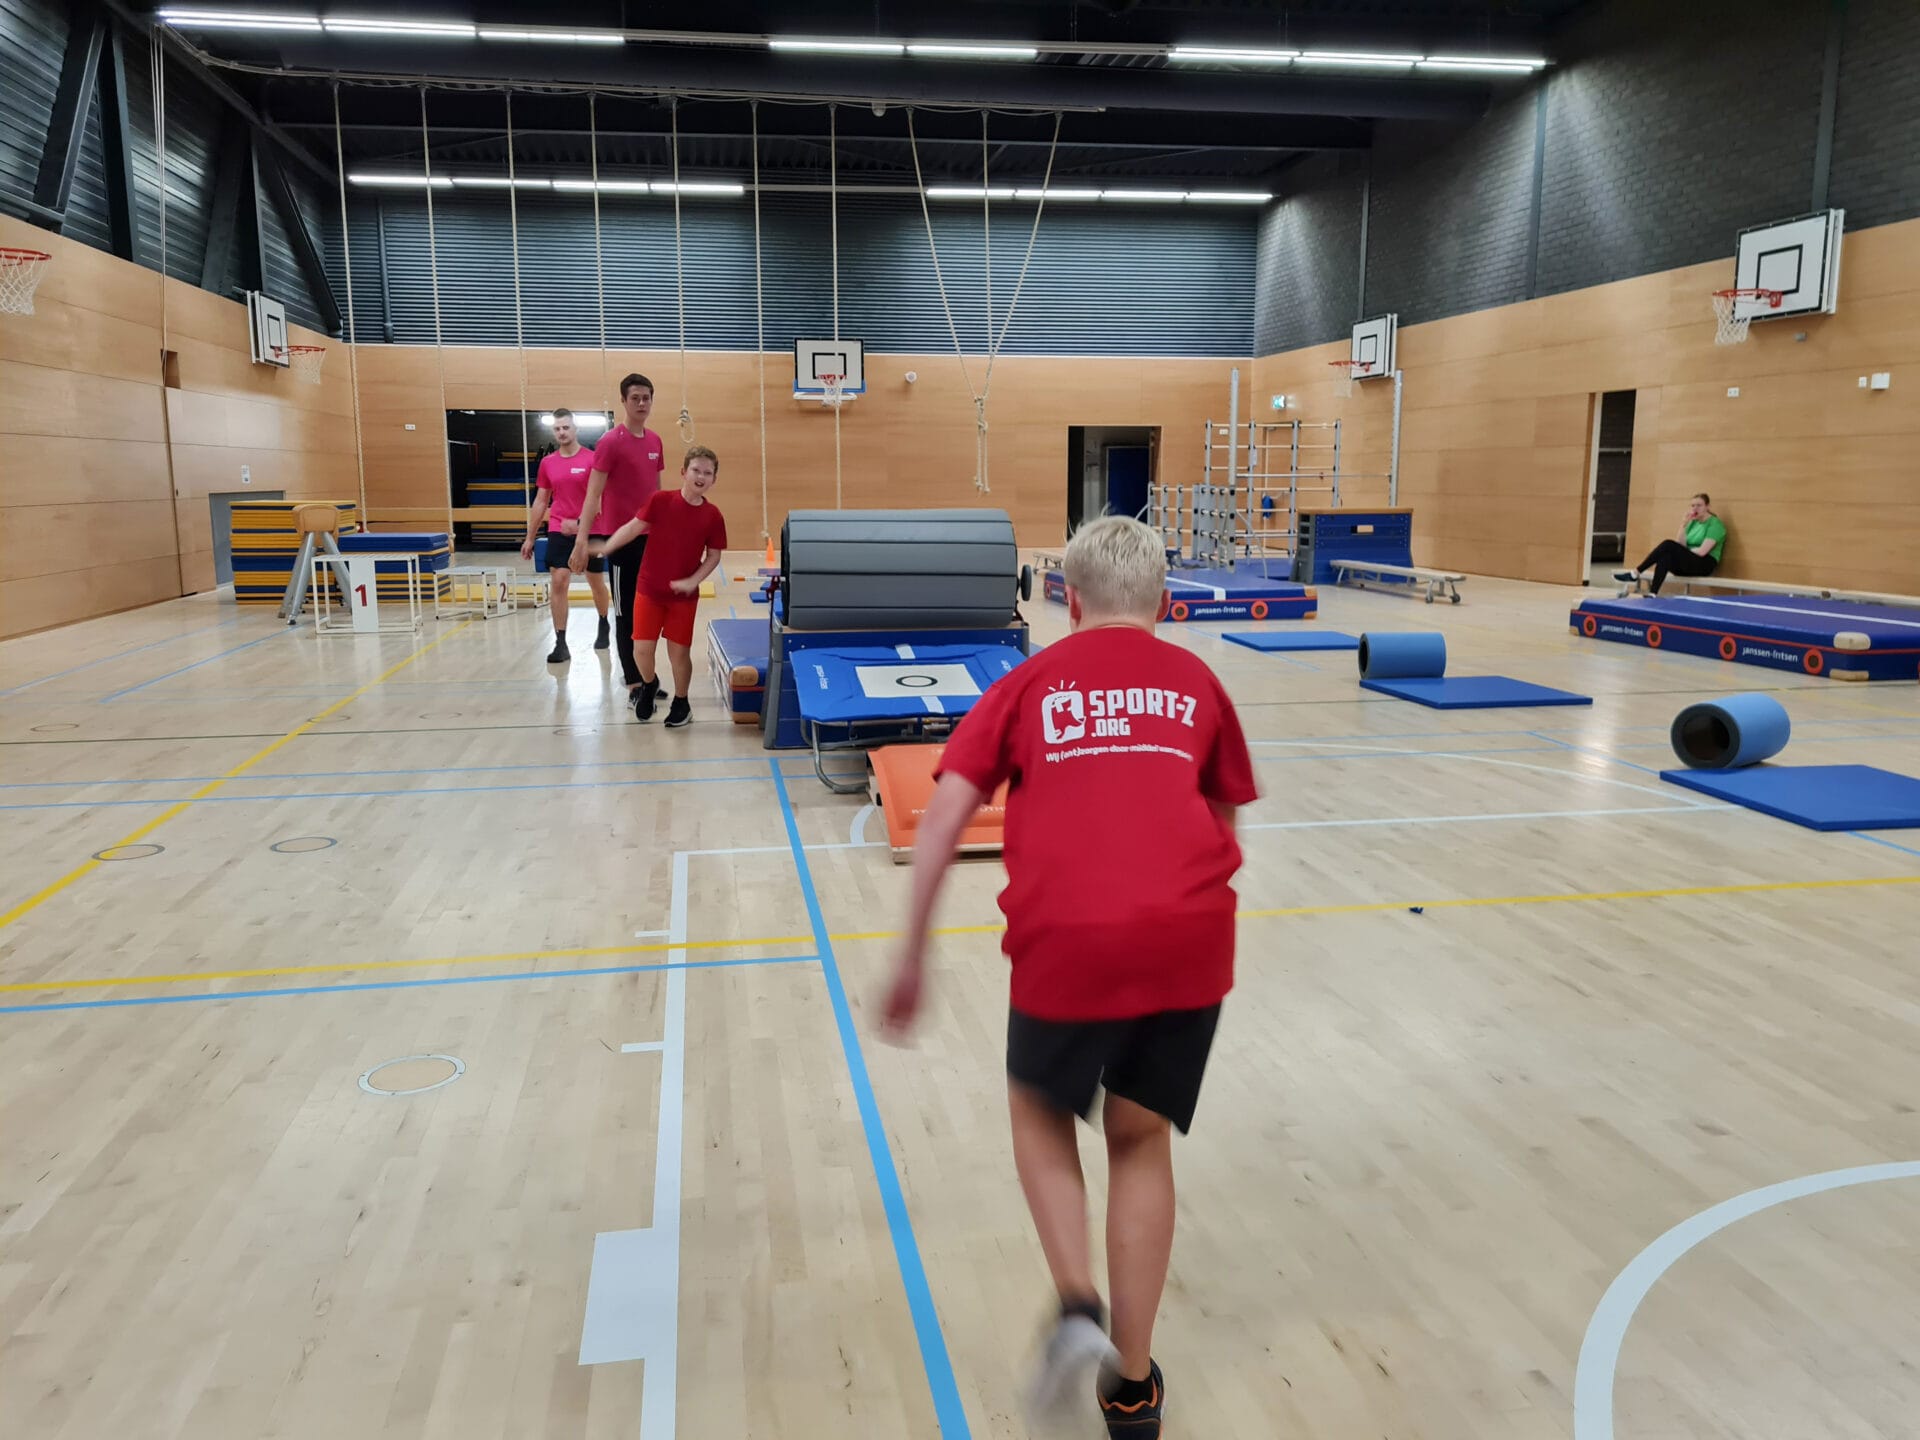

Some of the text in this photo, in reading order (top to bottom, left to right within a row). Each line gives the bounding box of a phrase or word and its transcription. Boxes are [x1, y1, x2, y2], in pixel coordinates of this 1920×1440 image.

[354, 583, 368, 607] 1
[499, 582, 507, 603] 2
[1742, 646, 1798, 662] janssen-fritsen
[1089, 688, 1197, 727] SPORT-Z
[1091, 717, 1131, 738] .ORG
